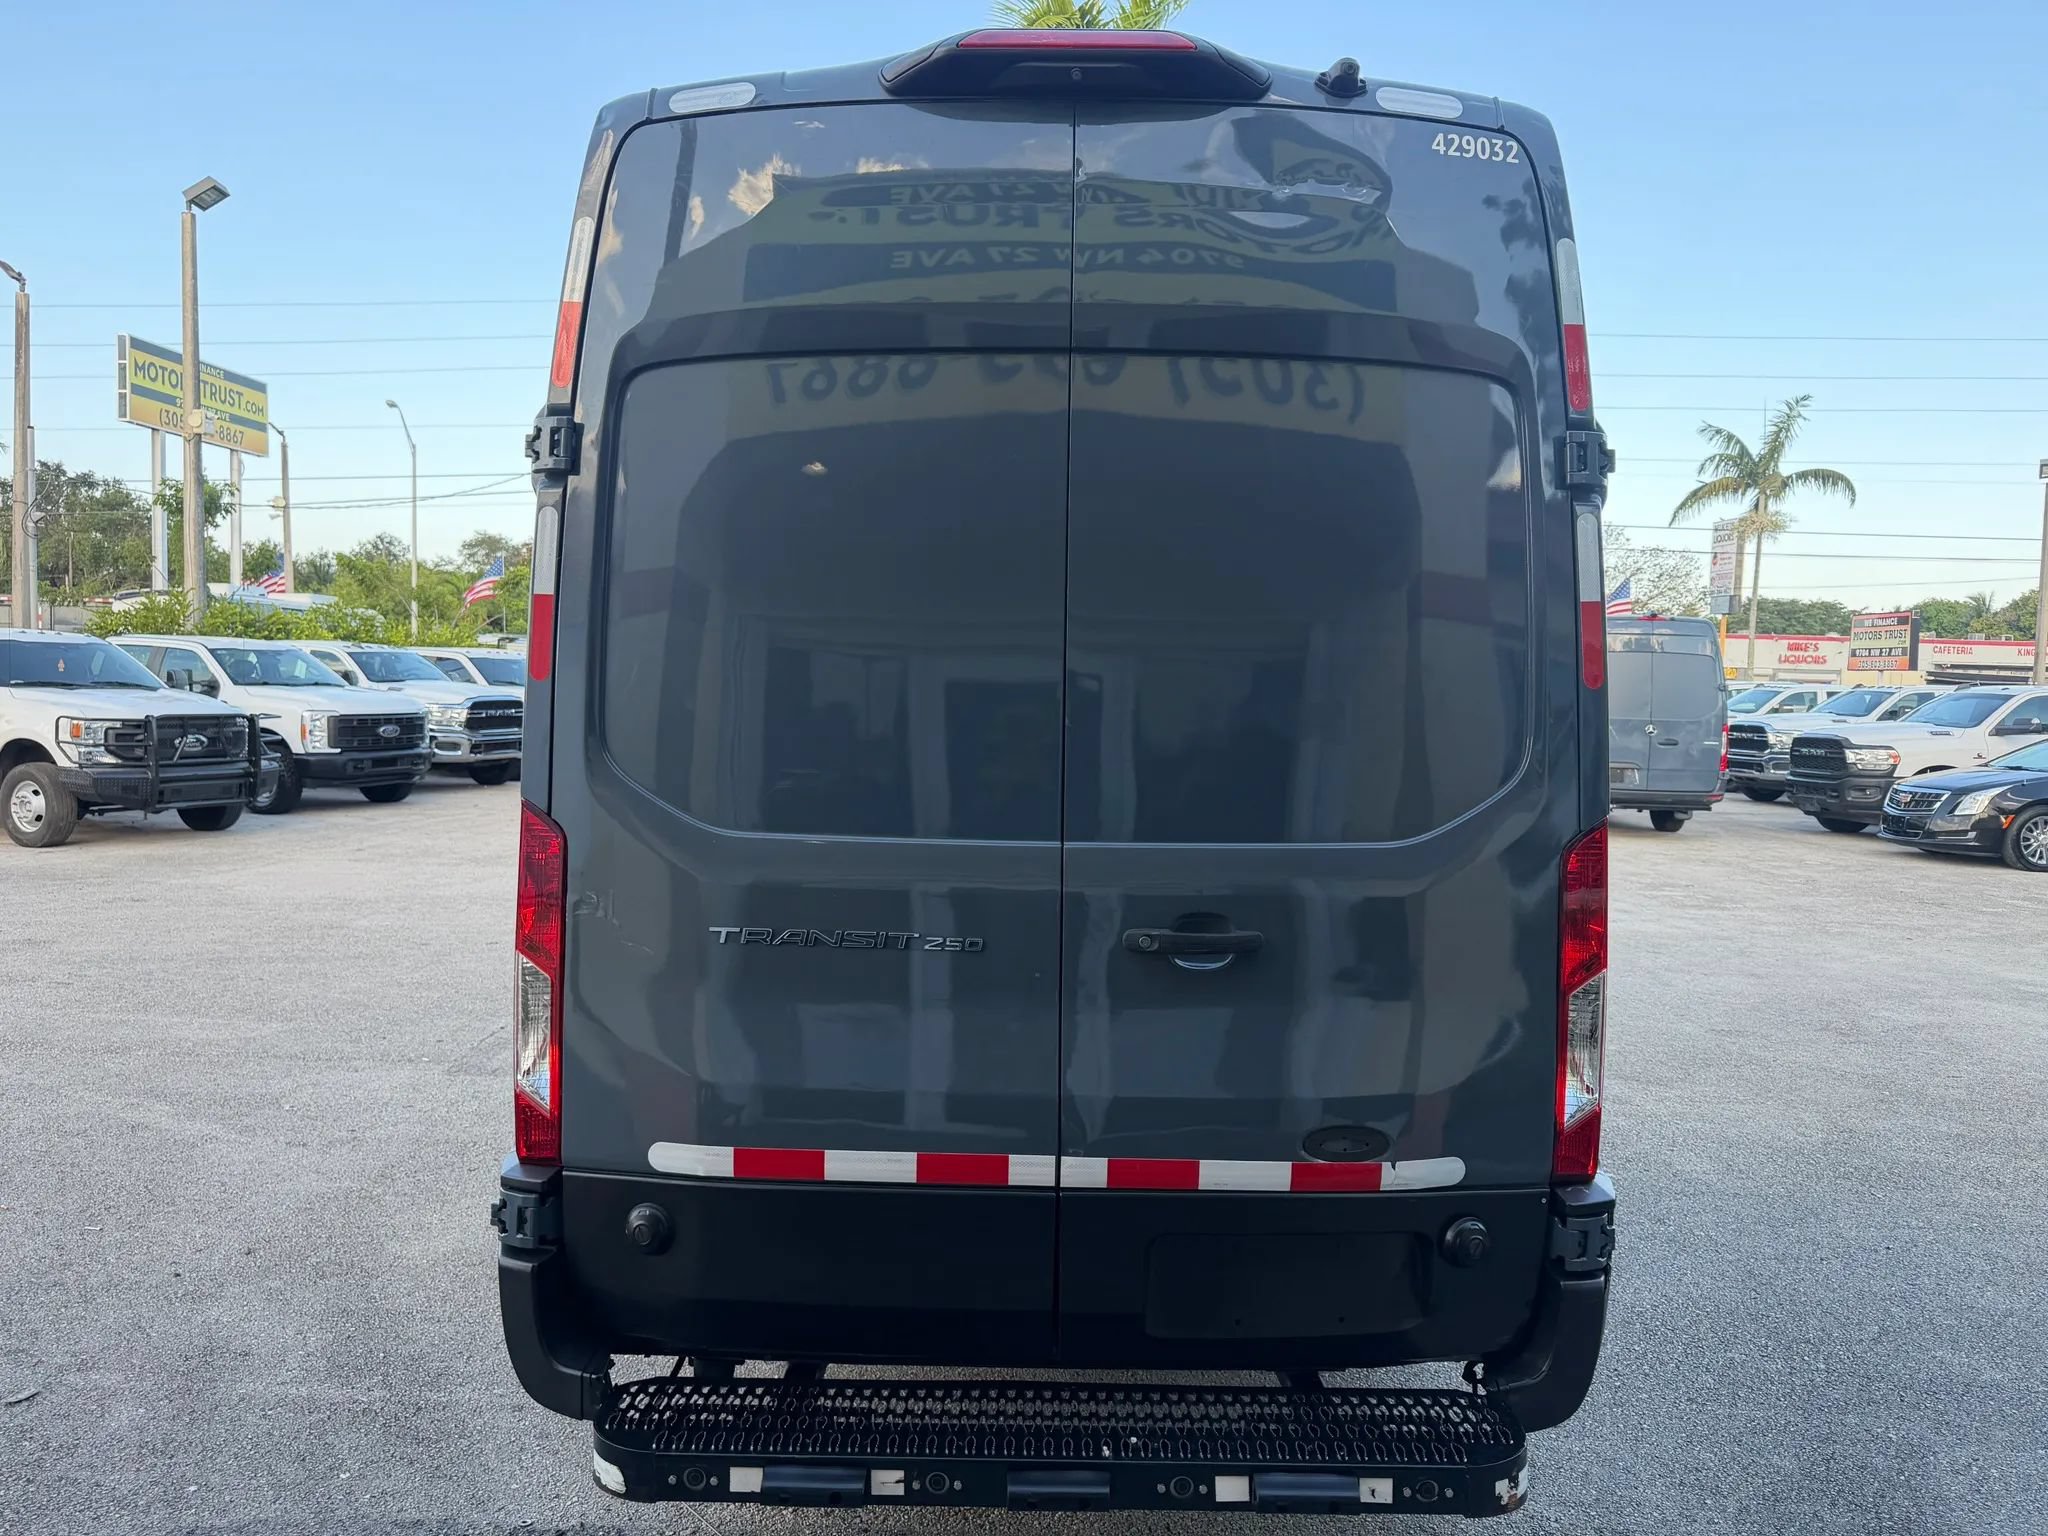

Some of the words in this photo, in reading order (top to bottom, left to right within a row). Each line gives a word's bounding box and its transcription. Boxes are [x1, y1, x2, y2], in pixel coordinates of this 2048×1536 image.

[1431, 132, 1520, 164] 429032
[199, 363, 225, 380] INANCE
[1874, 617, 1898, 626] FINANCE
[1853, 630, 1882, 641] MOTORS
[1884, 629, 1908, 640] TRUST
[1787, 642, 1821, 653] MIKE'S
[1891, 647, 1903, 657] AVE
[1933, 646, 1973, 656] CAFETERIA
[1777, 653, 1829, 665] LIQUORS
[708, 925, 921, 950] TRANSIT
[922, 937, 985, 952] 250
